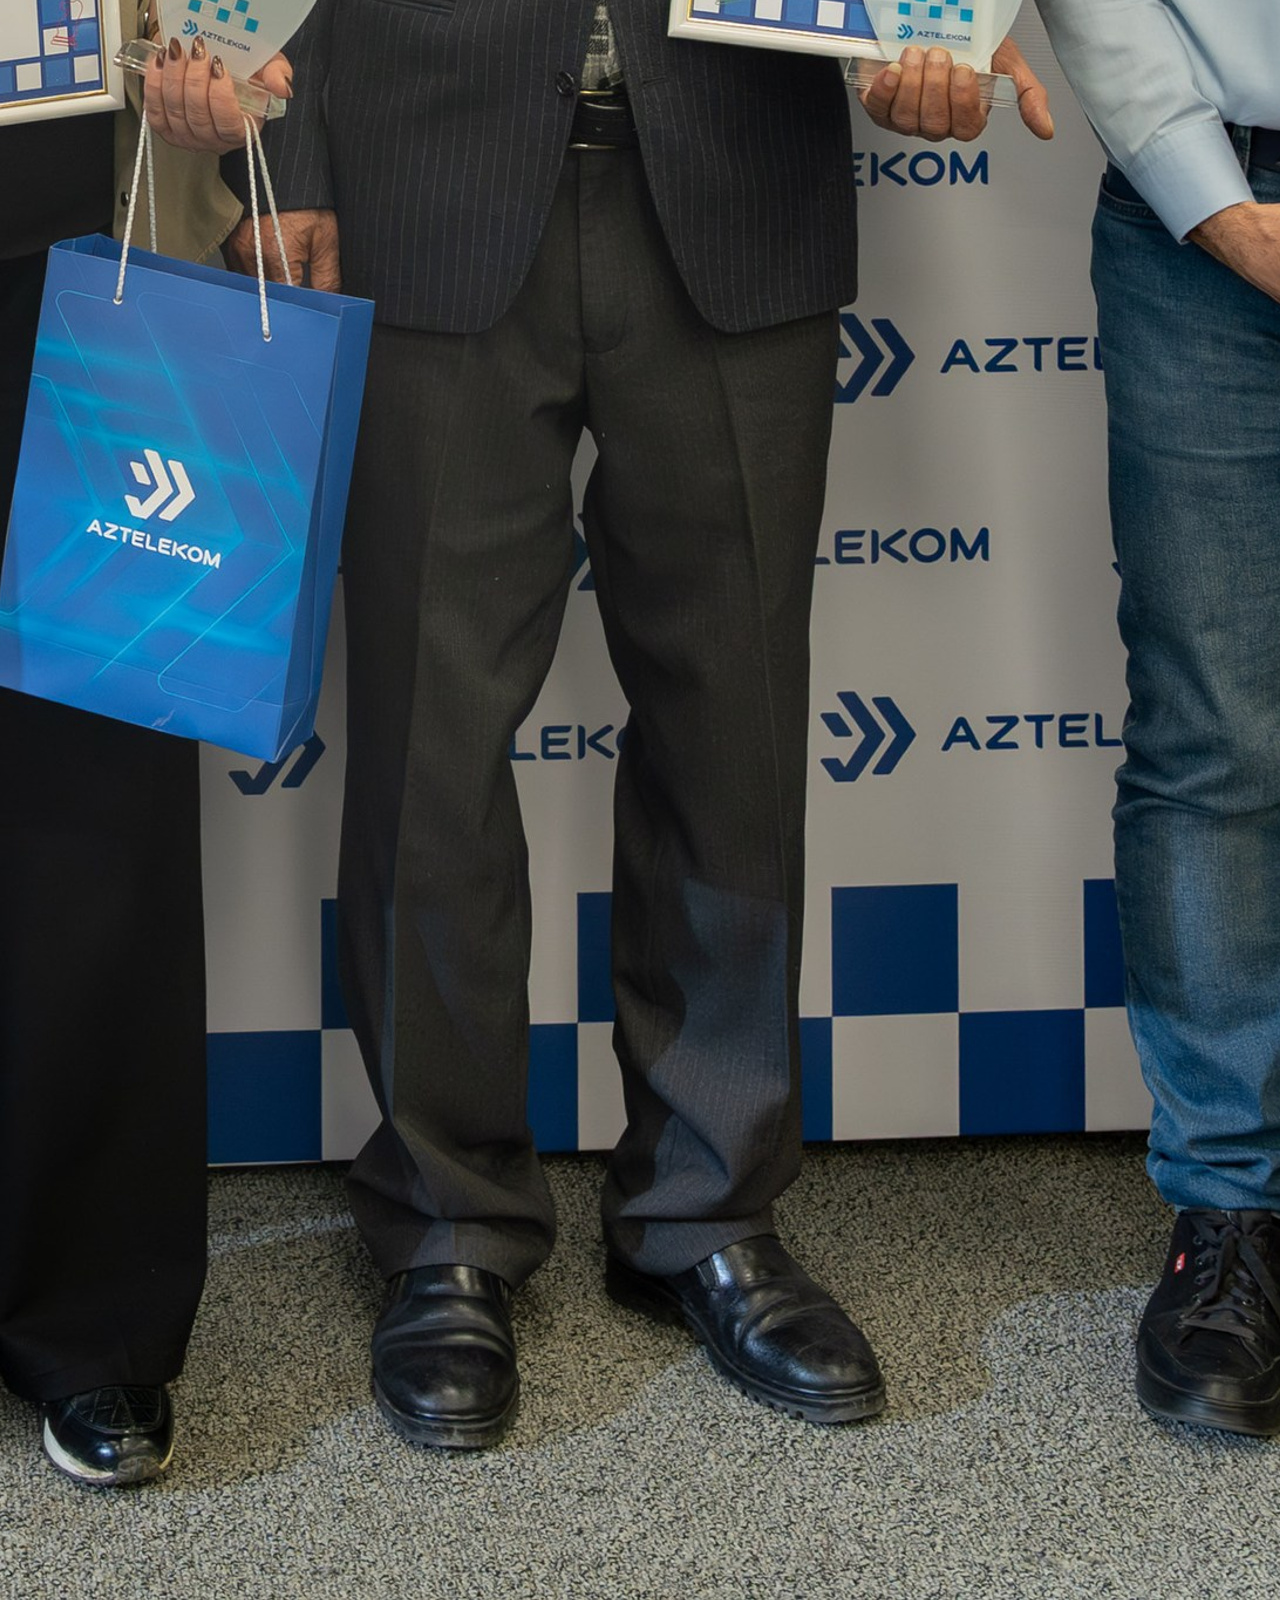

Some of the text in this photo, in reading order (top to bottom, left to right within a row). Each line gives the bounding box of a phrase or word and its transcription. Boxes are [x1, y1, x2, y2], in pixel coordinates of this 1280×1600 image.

[200, 30, 251, 52] AZTELEKOM
[917, 31, 971, 41] AZTELEKOM
[86, 519, 221, 569] AZTELEKOM
[509, 724, 625, 761] LEK
[941, 713, 1123, 751] AZTEL
